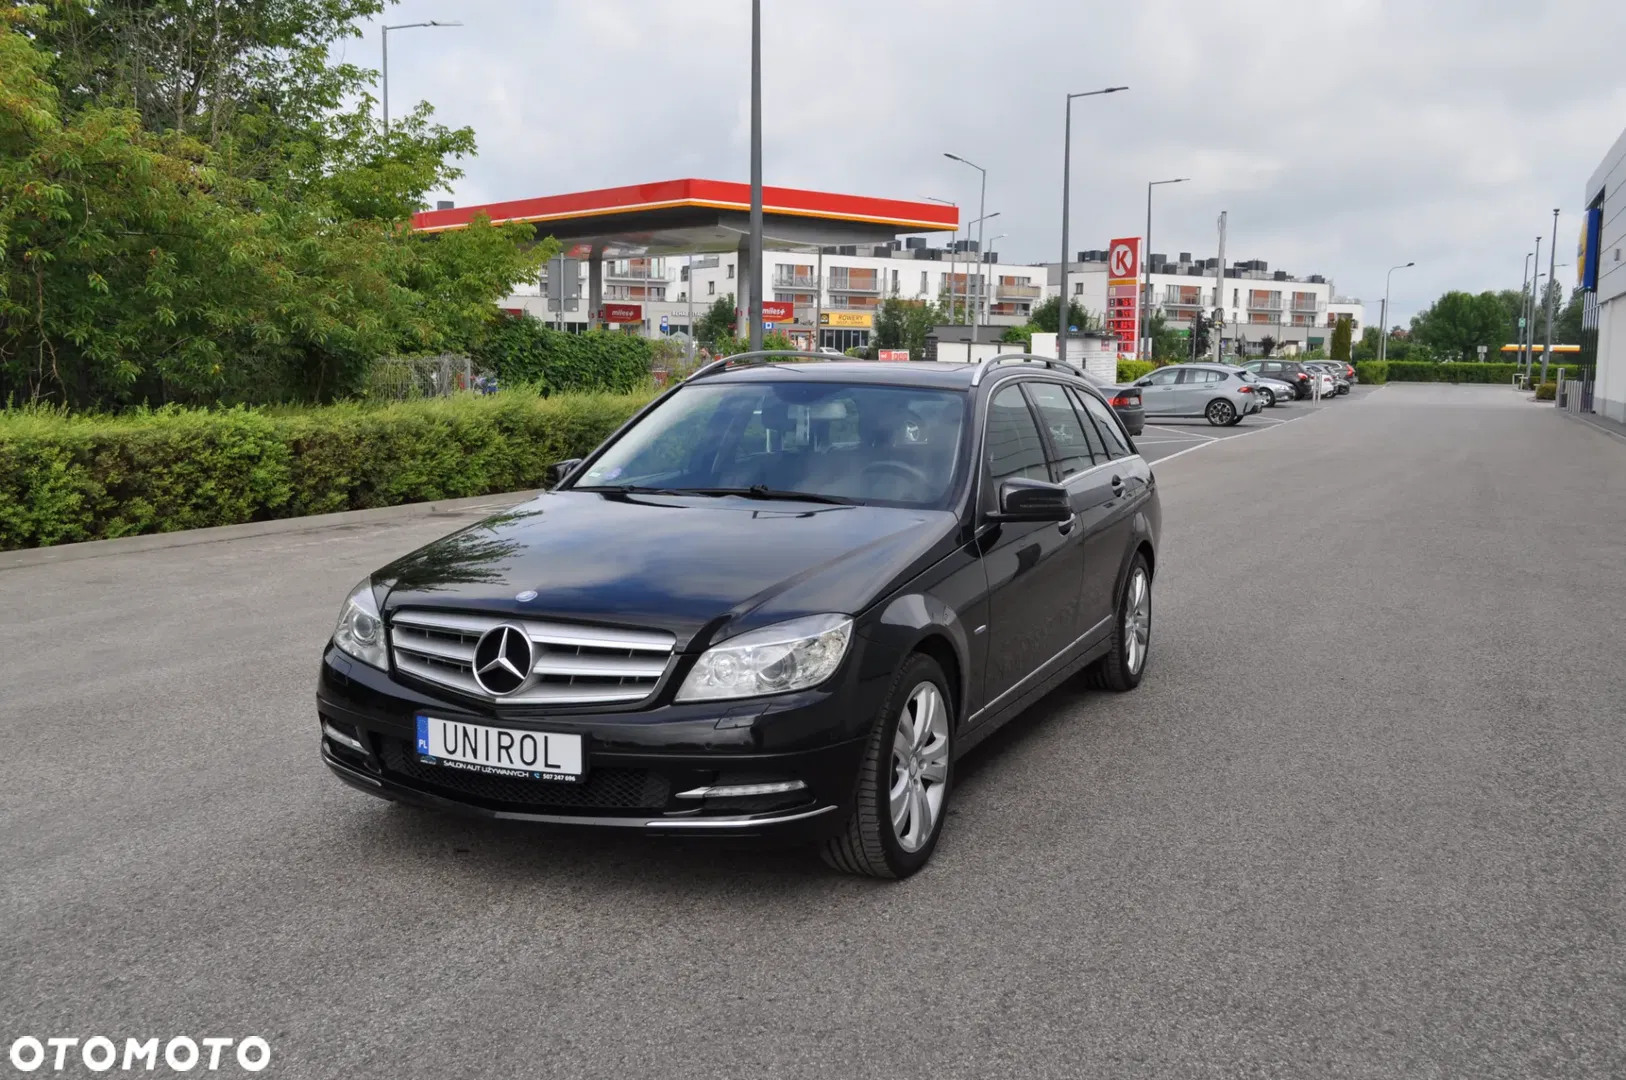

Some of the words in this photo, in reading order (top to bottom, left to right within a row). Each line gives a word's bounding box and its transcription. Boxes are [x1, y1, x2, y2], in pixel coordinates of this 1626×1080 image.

[1116, 250, 1129, 273] K
[418, 739, 428, 749] PL
[443, 722, 561, 769] UNIROL
[443, 760, 466, 770] SALON
[466, 764, 481, 772] AUT
[481, 766, 529, 778] UŻYWANYCH
